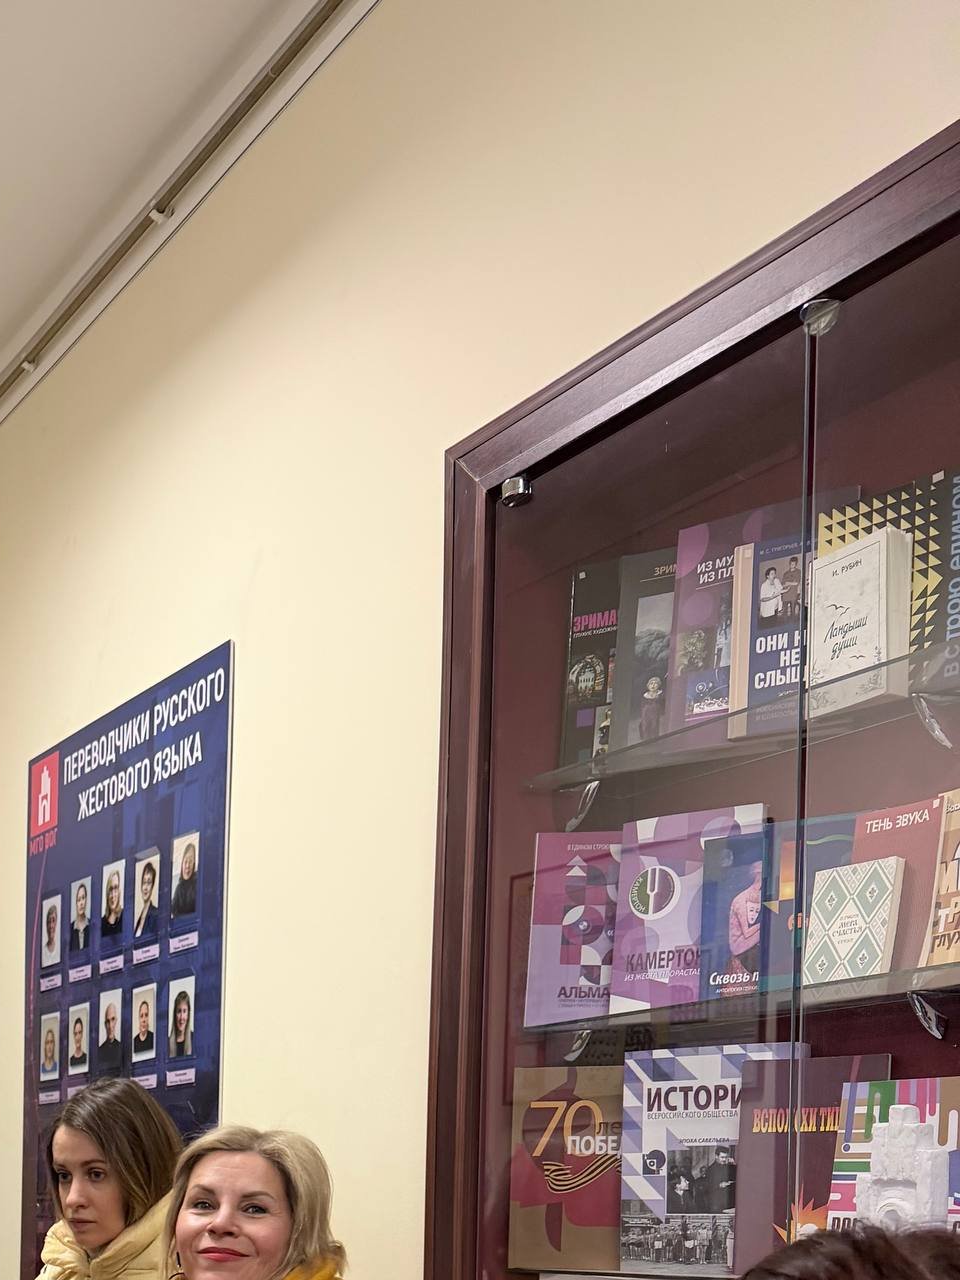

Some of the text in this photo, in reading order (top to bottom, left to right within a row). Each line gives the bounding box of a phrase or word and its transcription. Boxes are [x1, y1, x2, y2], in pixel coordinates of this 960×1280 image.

[697, 561, 713, 574] ИЗ
[841, 558, 862, 573] РУБИН
[699, 572, 715, 584] ИЗ
[573, 609, 617, 632] ЗРИМА
[824, 616, 868, 643] Ландыши
[755, 632, 789, 654] ОНИ
[831, 635, 858, 661] души
[780, 648, 800, 667] НЕ
[63, 667, 225, 786] ПЕРЕВОДЧИКИ РУССКОГО
[77, 731, 203, 822] ЖЕСТОВОГО ЯЗЫКА
[866, 808, 930, 834] ТЕНЬ ЗВУКА
[631, 877, 646, 913] КАМЕРТОН
[624, 974, 634, 982] ИЗ
[557, 985, 610, 998] АЛЬМА
[647, 1084, 741, 1112] ИСТОРИ
[647, 1110, 738, 1120] ВСЕРОССИЙСКОГО ОБЩЕСТВА
[530, 1100, 603, 1157] 70
[567, 1135, 622, 1157] ПОБЕ
